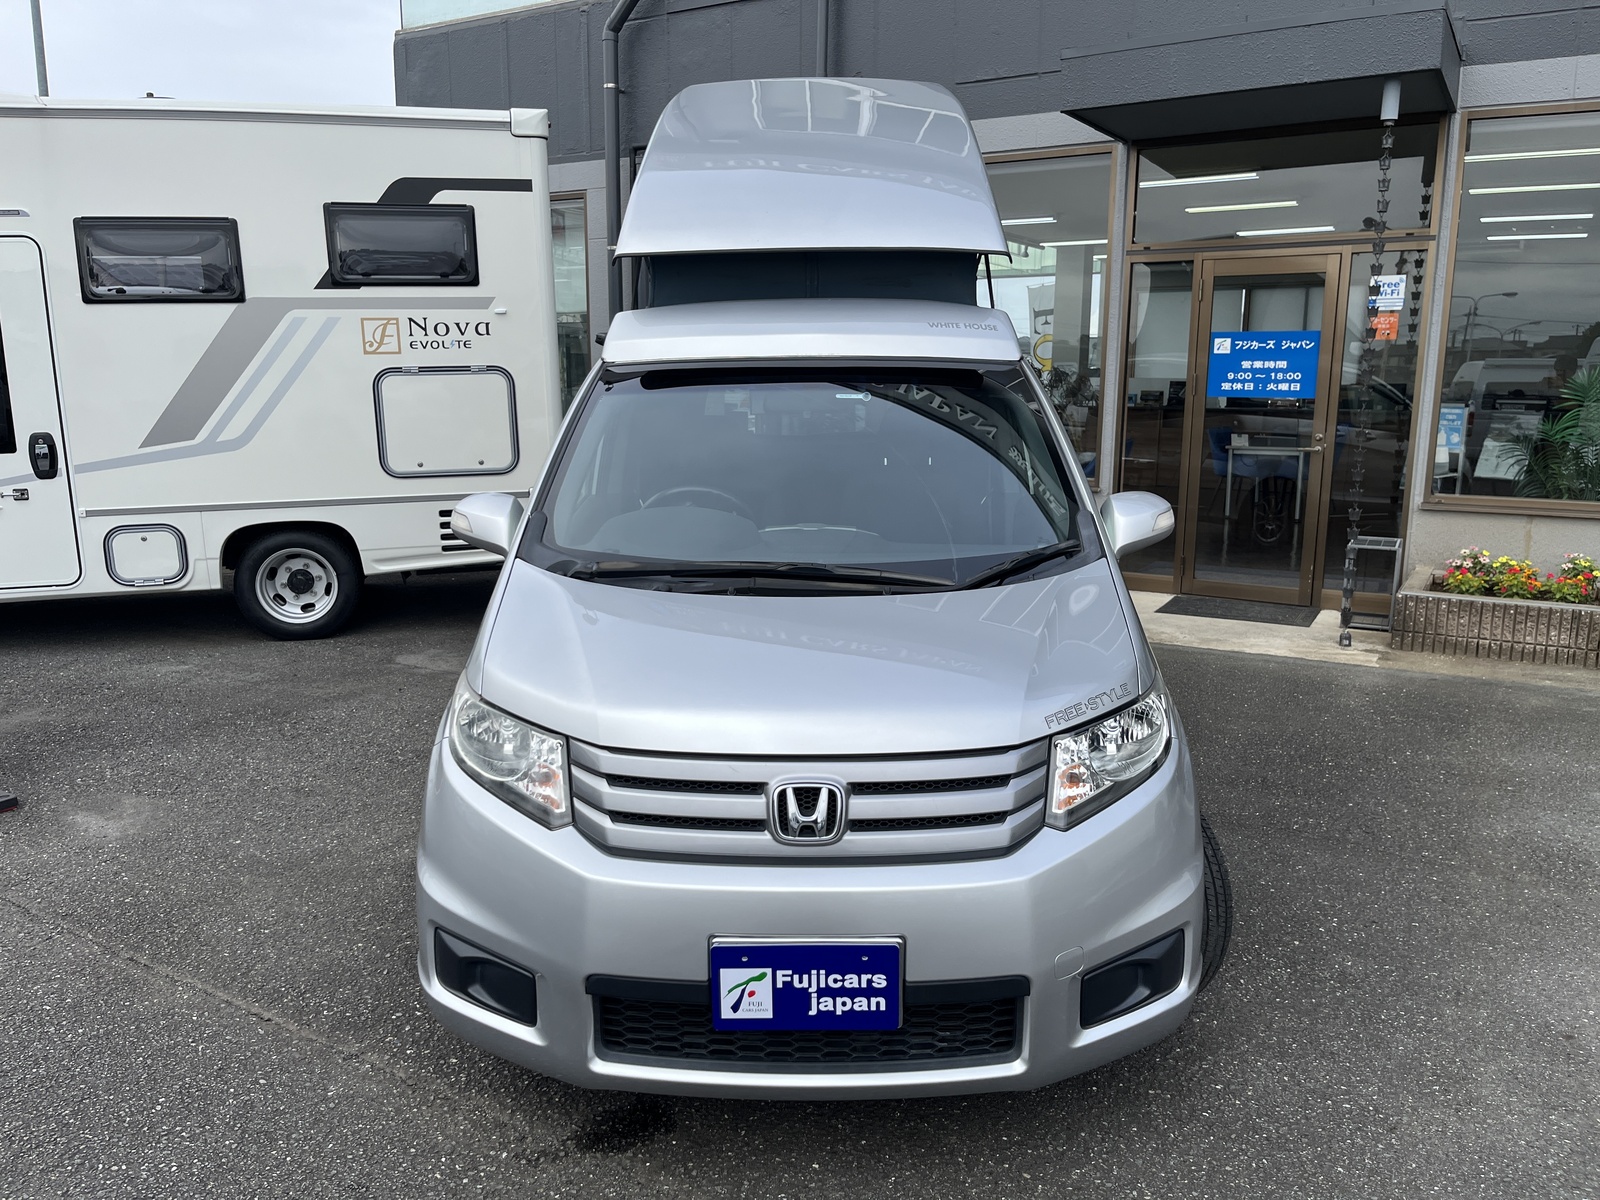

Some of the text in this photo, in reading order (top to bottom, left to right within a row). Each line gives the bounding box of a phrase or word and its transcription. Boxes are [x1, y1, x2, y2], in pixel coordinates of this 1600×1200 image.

[407, 317, 491, 337] Nova
[927, 321, 999, 332] WHITE HOUSE
[1281, 340, 1315, 350] ジャパン
[1241, 360, 1288, 369] 営業時間
[776, 969, 887, 992] Fujicars
[808, 992, 886, 1015] japan
